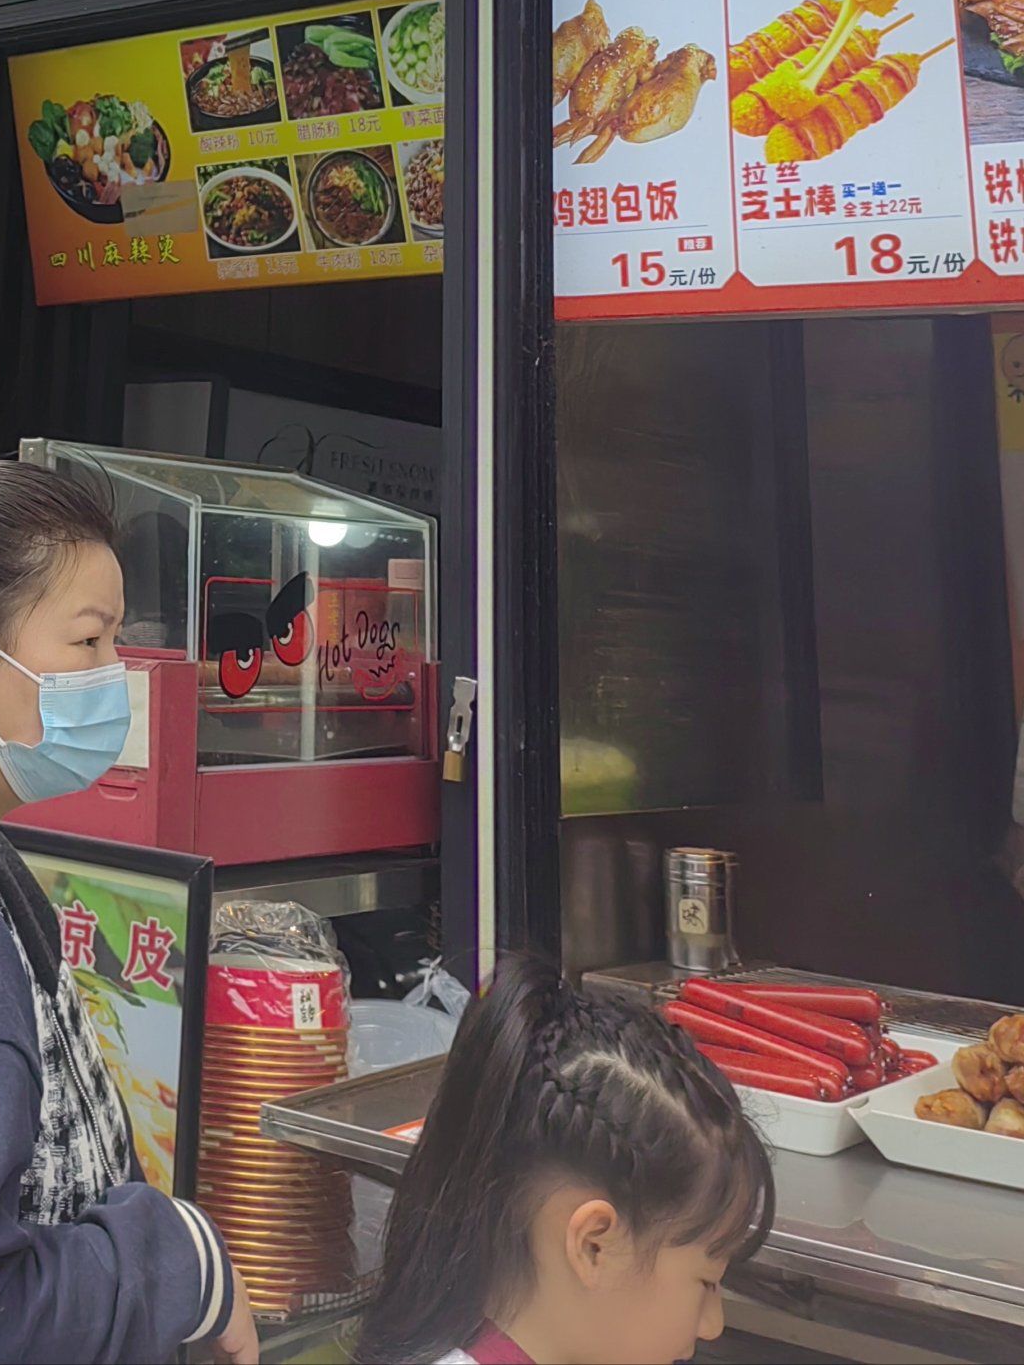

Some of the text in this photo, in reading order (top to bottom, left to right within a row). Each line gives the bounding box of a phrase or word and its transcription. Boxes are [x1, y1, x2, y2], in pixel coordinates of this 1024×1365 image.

[349, 114, 381, 134] 18元
[741, 160, 801, 187] 拉丝
[842, 181, 902, 198] 买一送一
[553, 180, 679, 228] 鸡翅包饭
[741, 184, 837, 221] 芝士棒
[842, 197, 923, 218] 全芝士22元
[49, 234, 181, 272] 四川麻辣烫
[988, 218, 1024, 264] 铁
[317, 623, 352, 691] Hot
[355, 610, 401, 661] Dogs
[54, 900, 176, 991] 凉皮
